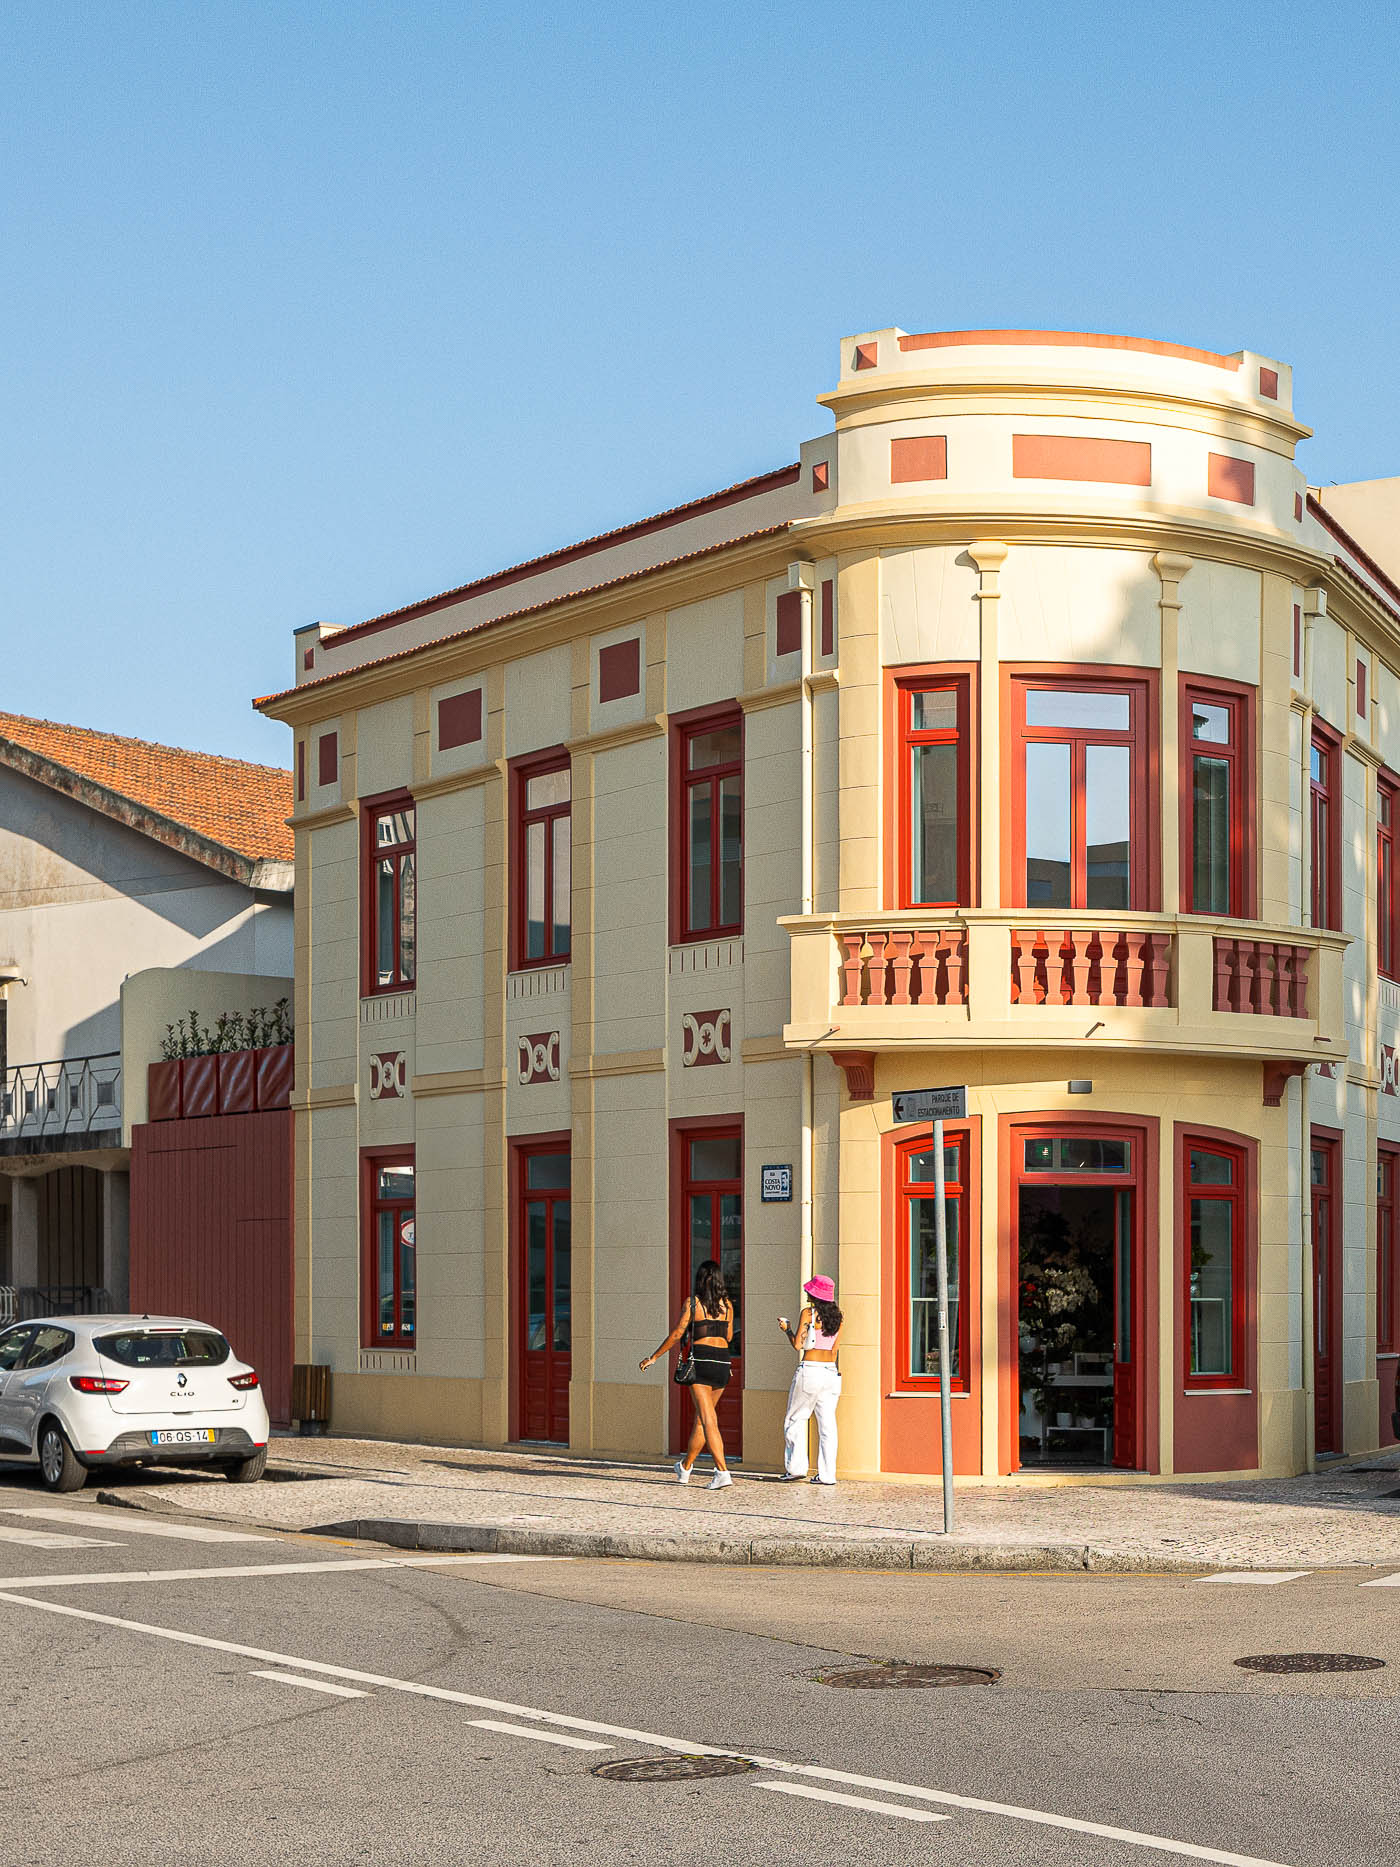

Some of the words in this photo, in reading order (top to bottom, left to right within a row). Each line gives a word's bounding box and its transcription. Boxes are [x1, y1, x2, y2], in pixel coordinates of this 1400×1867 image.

[931, 1093, 952, 1104] PARQUE
[952, 1092, 960, 1102] DE
[917, 1105, 960, 1118] ESTACIONAMENTO
